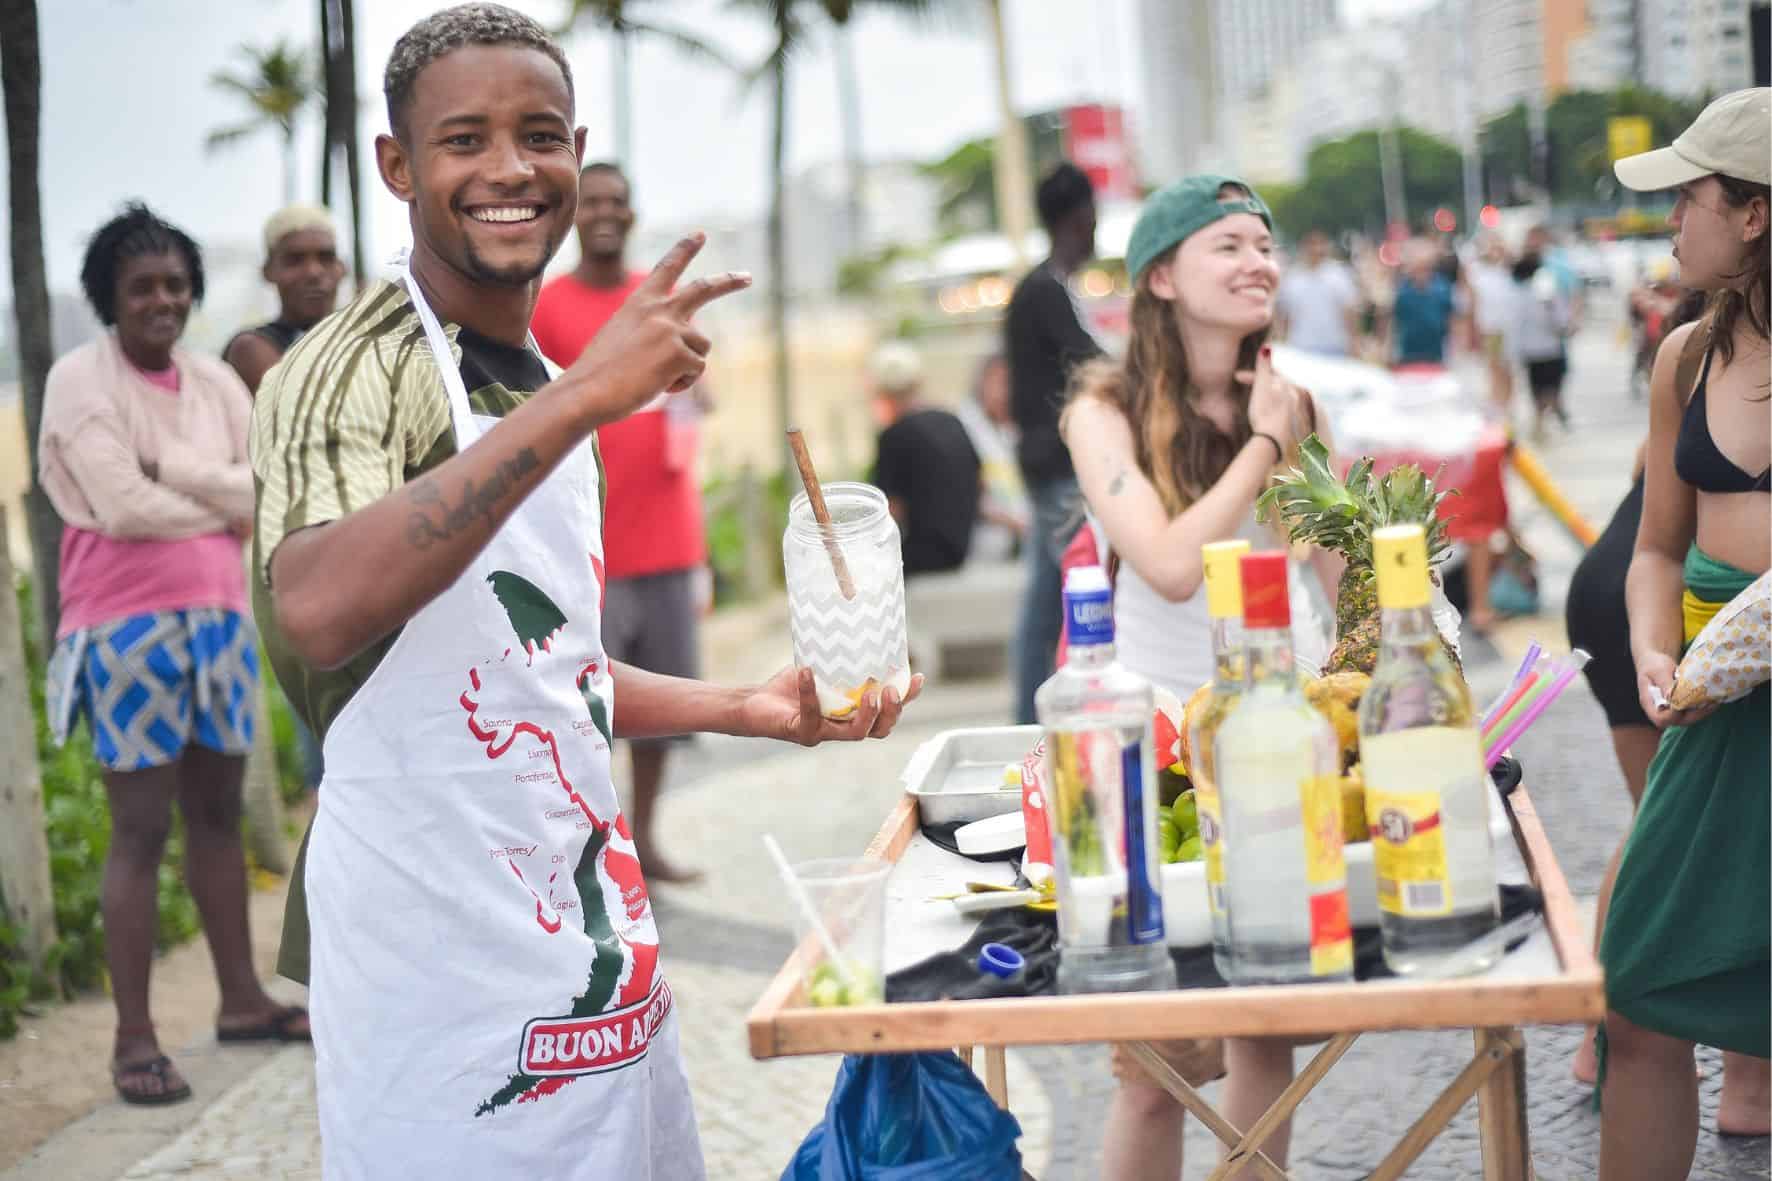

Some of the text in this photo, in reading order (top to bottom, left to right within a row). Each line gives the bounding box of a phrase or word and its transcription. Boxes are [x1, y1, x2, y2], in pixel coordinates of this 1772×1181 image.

[483, 718, 513, 729] Savona
[503, 847, 529, 857] Torres
[530, 1022, 622, 1064] BUON
